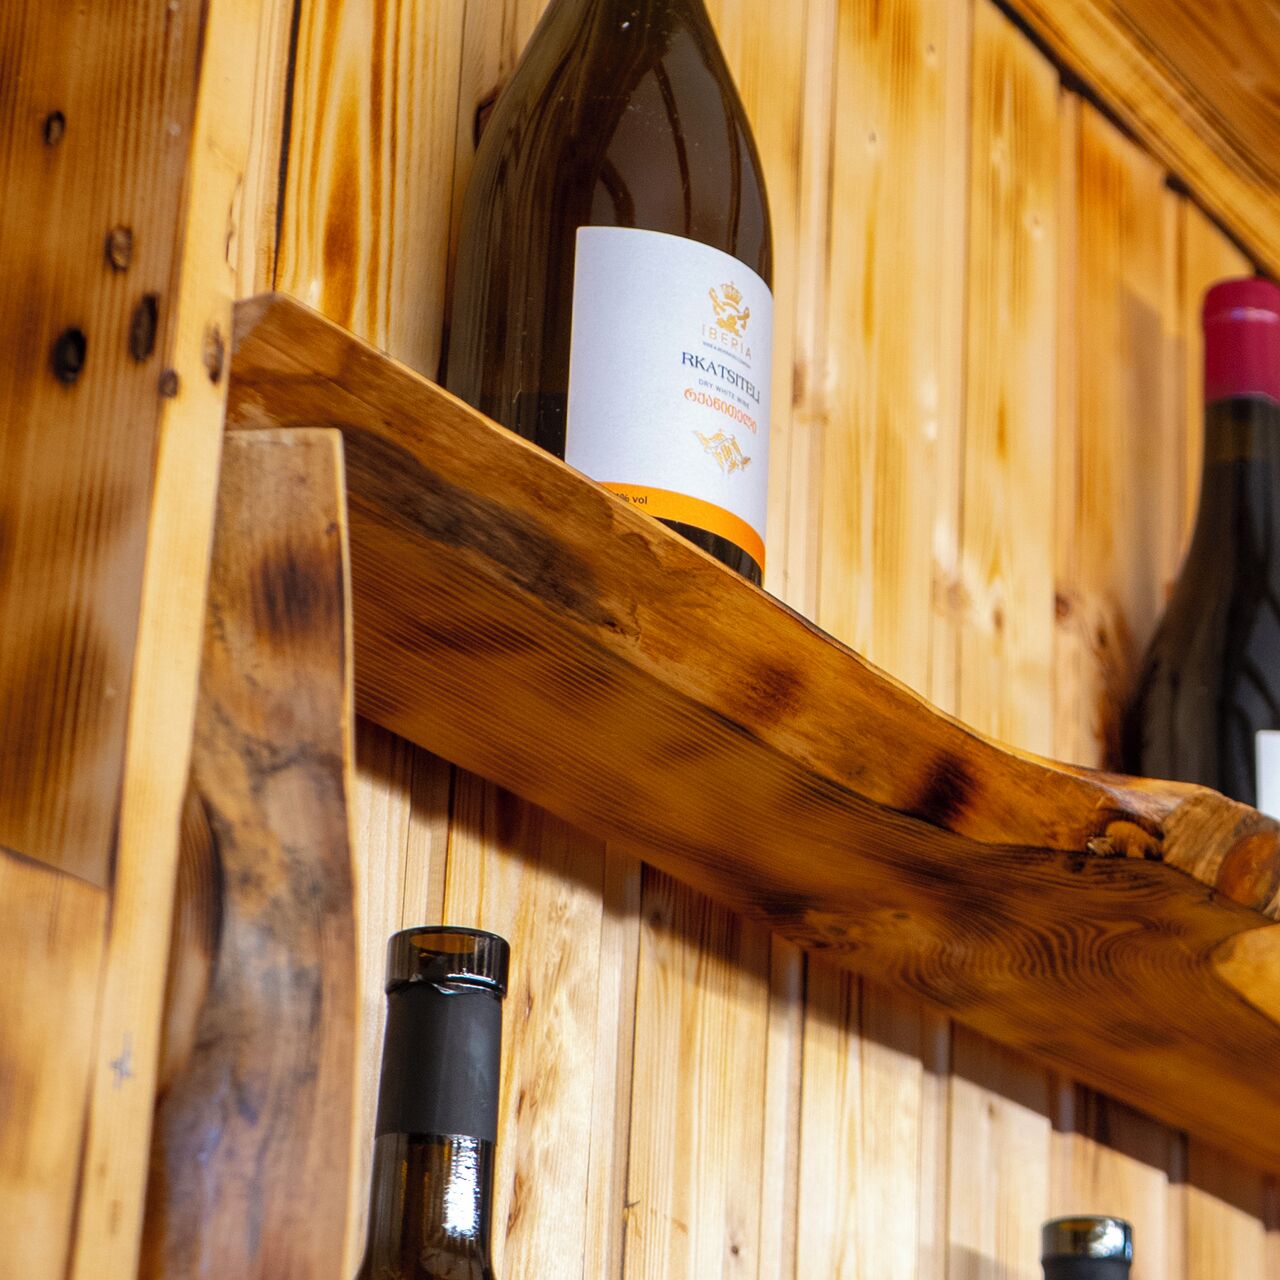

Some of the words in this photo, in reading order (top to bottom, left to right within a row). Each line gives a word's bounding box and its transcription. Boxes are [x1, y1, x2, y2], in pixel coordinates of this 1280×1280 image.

[701, 324, 752, 360] IBERIA
[681, 351, 760, 404] RKATSITELI
[698, 378, 713, 390] DRY
[715, 384, 736, 399] WHITE
[632, 496, 648, 504] vol
